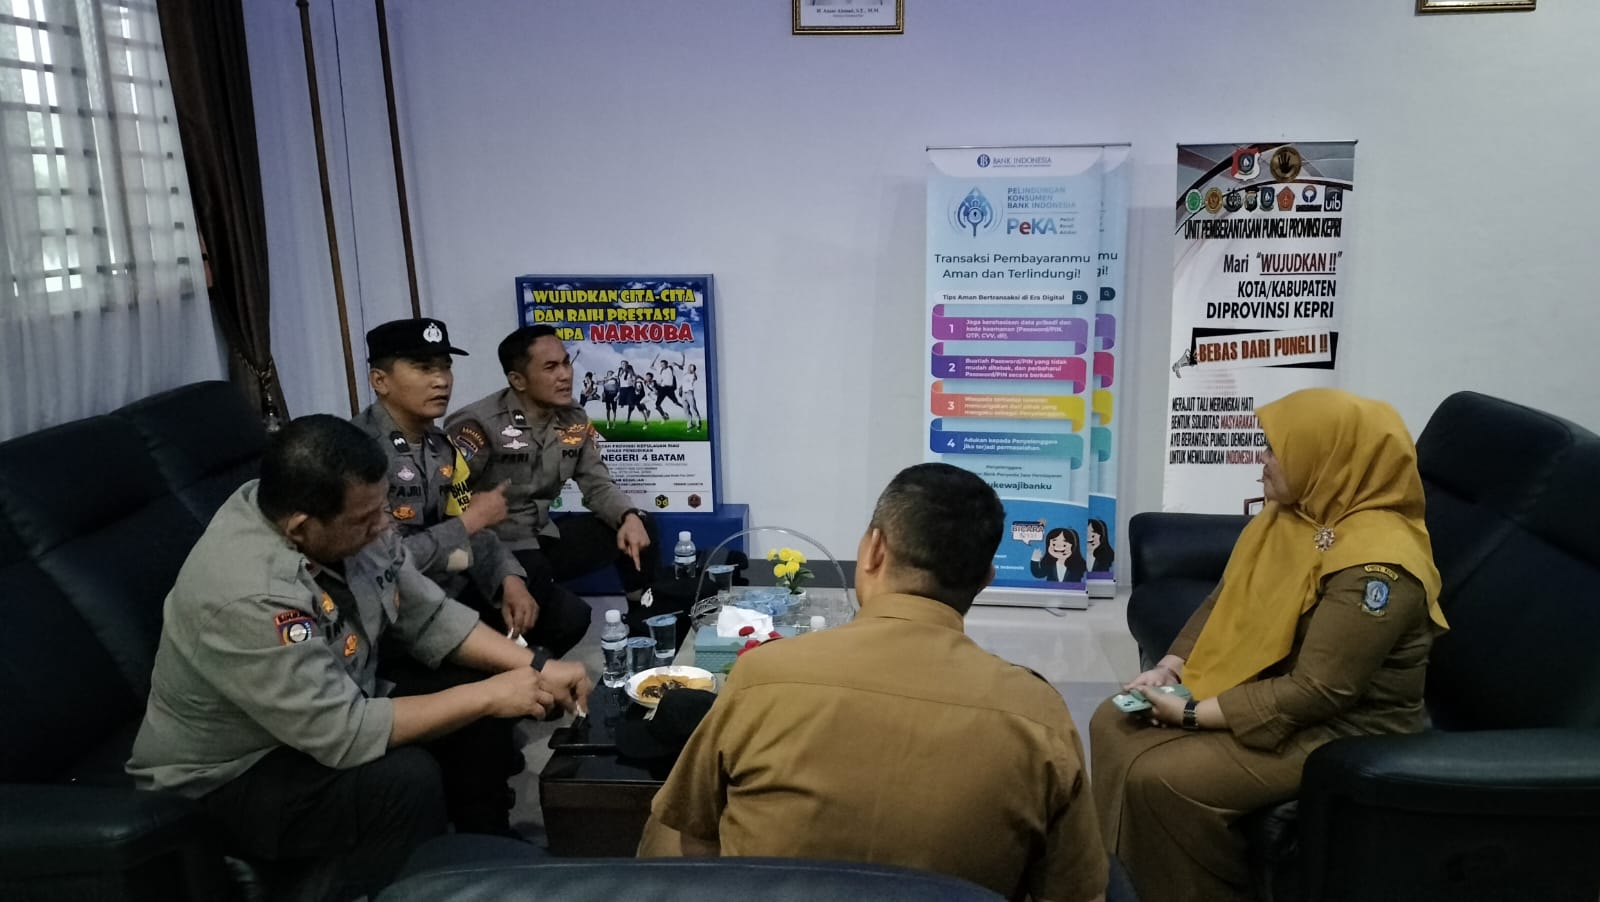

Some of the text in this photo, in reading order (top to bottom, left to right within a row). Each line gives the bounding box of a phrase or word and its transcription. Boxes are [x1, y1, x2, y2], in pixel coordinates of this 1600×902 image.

[1325, 194, 1341, 210] uib
[1006, 218, 1058, 235] PeKA
[1184, 218, 1342, 240] UNIT PEMBERANTASAN PUNGLI PROVINSI KEPRI
[934, 254, 990, 264] Transaksi
[994, 254, 1091, 265] Pembayaranmu
[1223, 254, 1249, 273] Mari
[942, 269, 1081, 280] Aman dan Terlindungi!
[533, 288, 696, 304] WUJUDKAN CITA-CITA
[1238, 280, 1336, 300] KOTA/KABUPATEN
[533, 308, 678, 322] DAN RAIH PRESTASI
[1206, 301, 1334, 319] DIPROVINSI KEPRI
[556, 322, 694, 343] NPA NARKOBA
[948, 324, 954, 334] 1
[1199, 334, 1328, 363] BEBAS DARI PUNGLI !!
[948, 363, 956, 372] 2
[947, 401, 956, 410] 3
[1209, 397, 1240, 412] MERANGKAI
[1241, 397, 1254, 412] HATI
[1171, 414, 1190, 430] BENTUK
[1192, 414, 1220, 430] SOLIDITAS
[1220, 414, 1256, 430] MASYARAKAT
[946, 438, 956, 448] 4
[1170, 432, 1180, 447] AYO
[1181, 432, 1208, 447] BERANTAS
[1210, 432, 1230, 447] PUNGLI
[1230, 432, 1252, 447] DENGAN
[1170, 450, 1186, 464] UNTUK
[1187, 450, 1224, 464] MEWUJUDKAN
[1226, 450, 1254, 464] INDONESIA
[988, 481, 1052, 490] ukewajibanku
